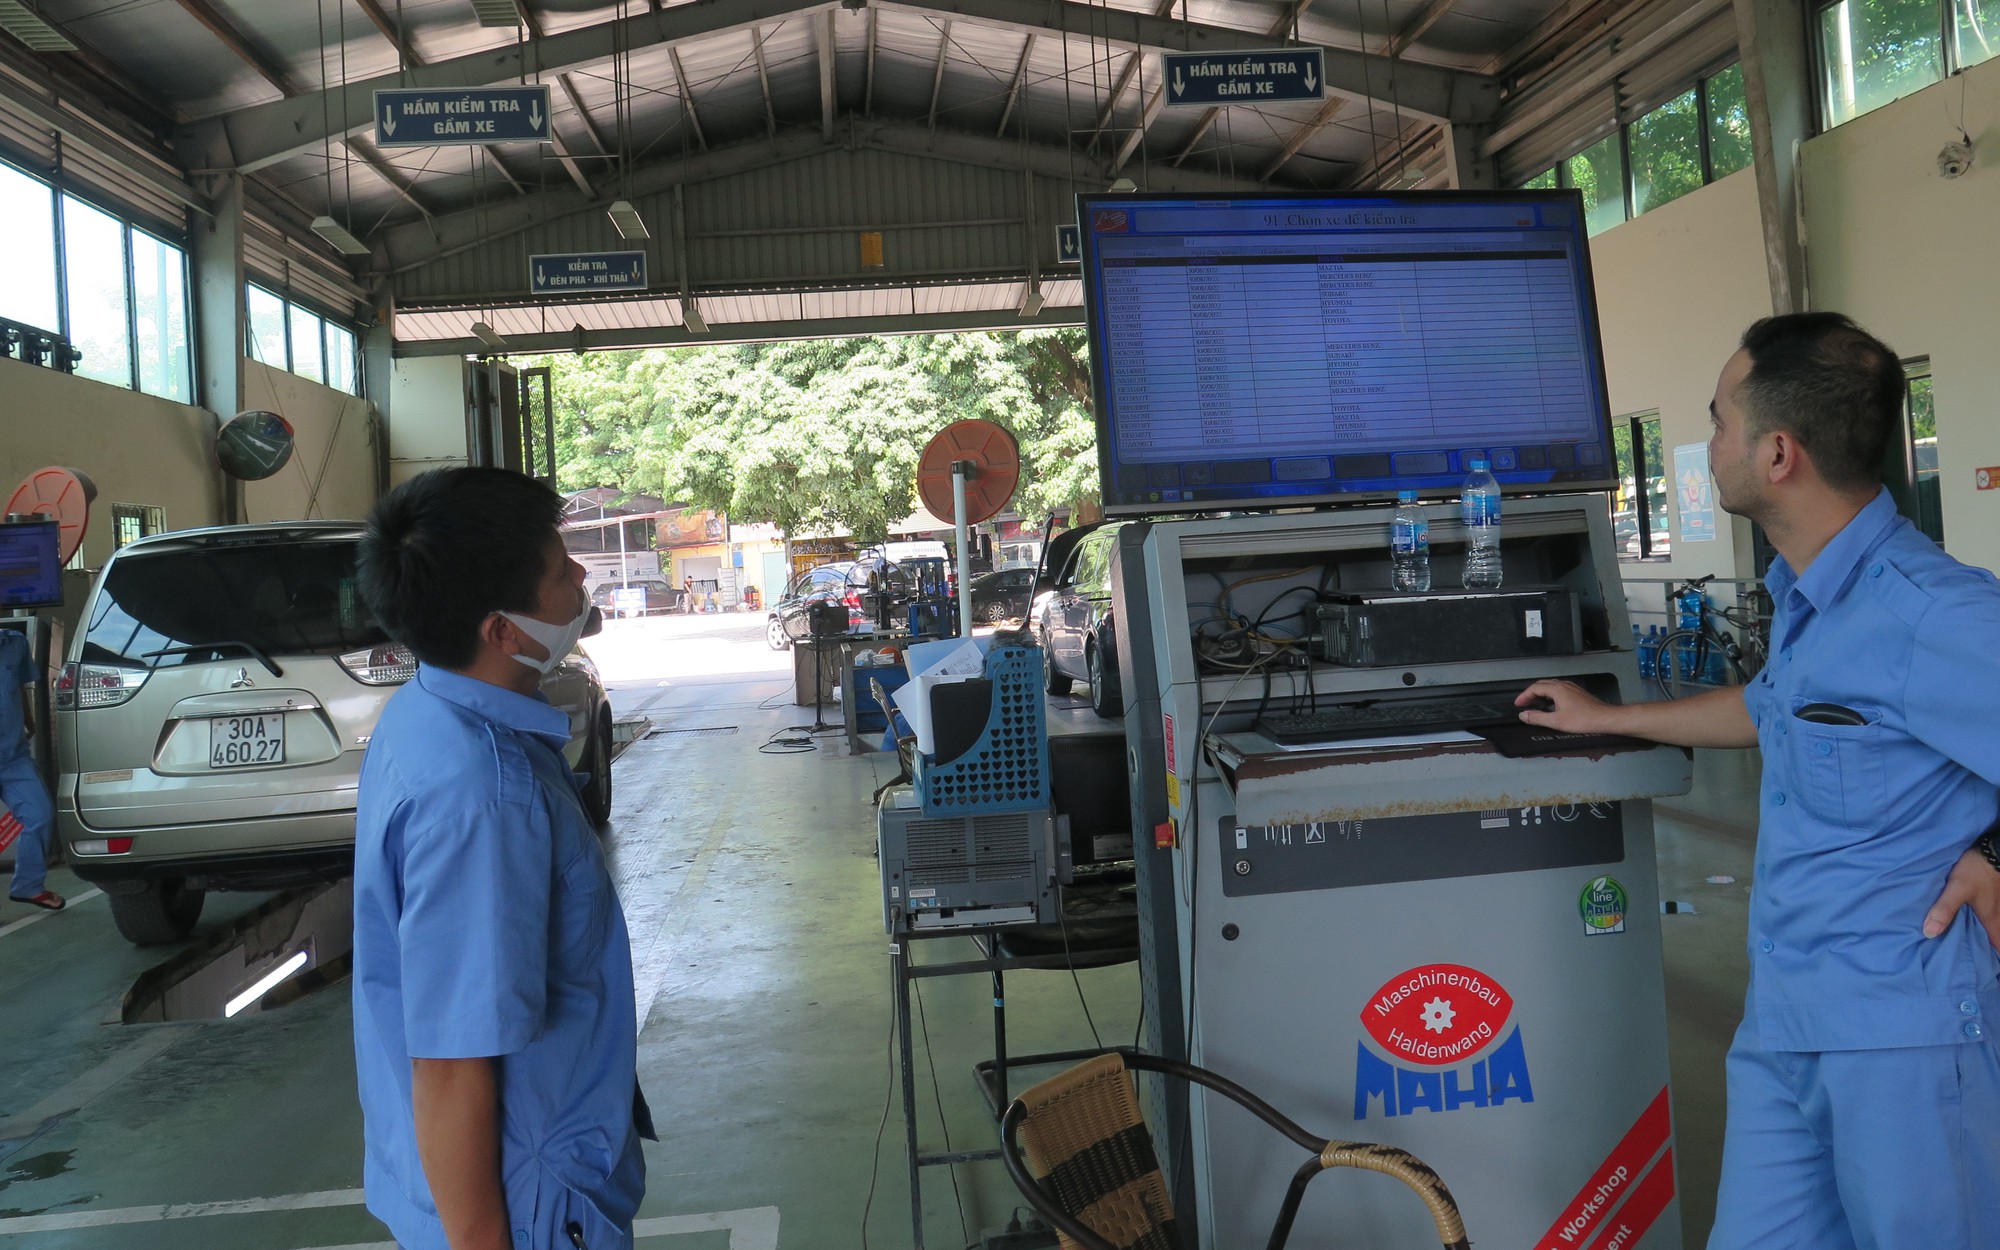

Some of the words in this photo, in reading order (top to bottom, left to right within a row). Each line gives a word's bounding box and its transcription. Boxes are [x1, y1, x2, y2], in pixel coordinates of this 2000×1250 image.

[1190, 60, 1223, 77] HẦM
[1228, 58, 1264, 75] KIỂM
[1269, 62, 1297, 74] TRA
[1256, 82, 1274, 93] XE
[403, 98, 439, 115] HẦM
[445, 95, 484, 114] KIỂM
[490, 100, 520, 112] TRA
[433, 117, 470, 134] GẦM
[475, 120, 495, 132] XE
[1264, 215, 1277, 227] 91
[1326, 217, 1340, 226] xe
[1400, 215, 1416, 225] tra
[568, 258, 590, 272] KIỂM
[591, 261, 608, 271] TRA
[569, 276, 586, 285] PHA
[229, 717, 266, 740] 30A
[213, 739, 281, 765] 460.27
[1593, 891, 1613, 902] line
[1374, 969, 1501, 1017] Maschinenbau
[1387, 1021, 1492, 1059] Haldenwang
[1354, 1023, 1534, 1120] MAHA
[1559, 1165, 1628, 1243] Workshop
